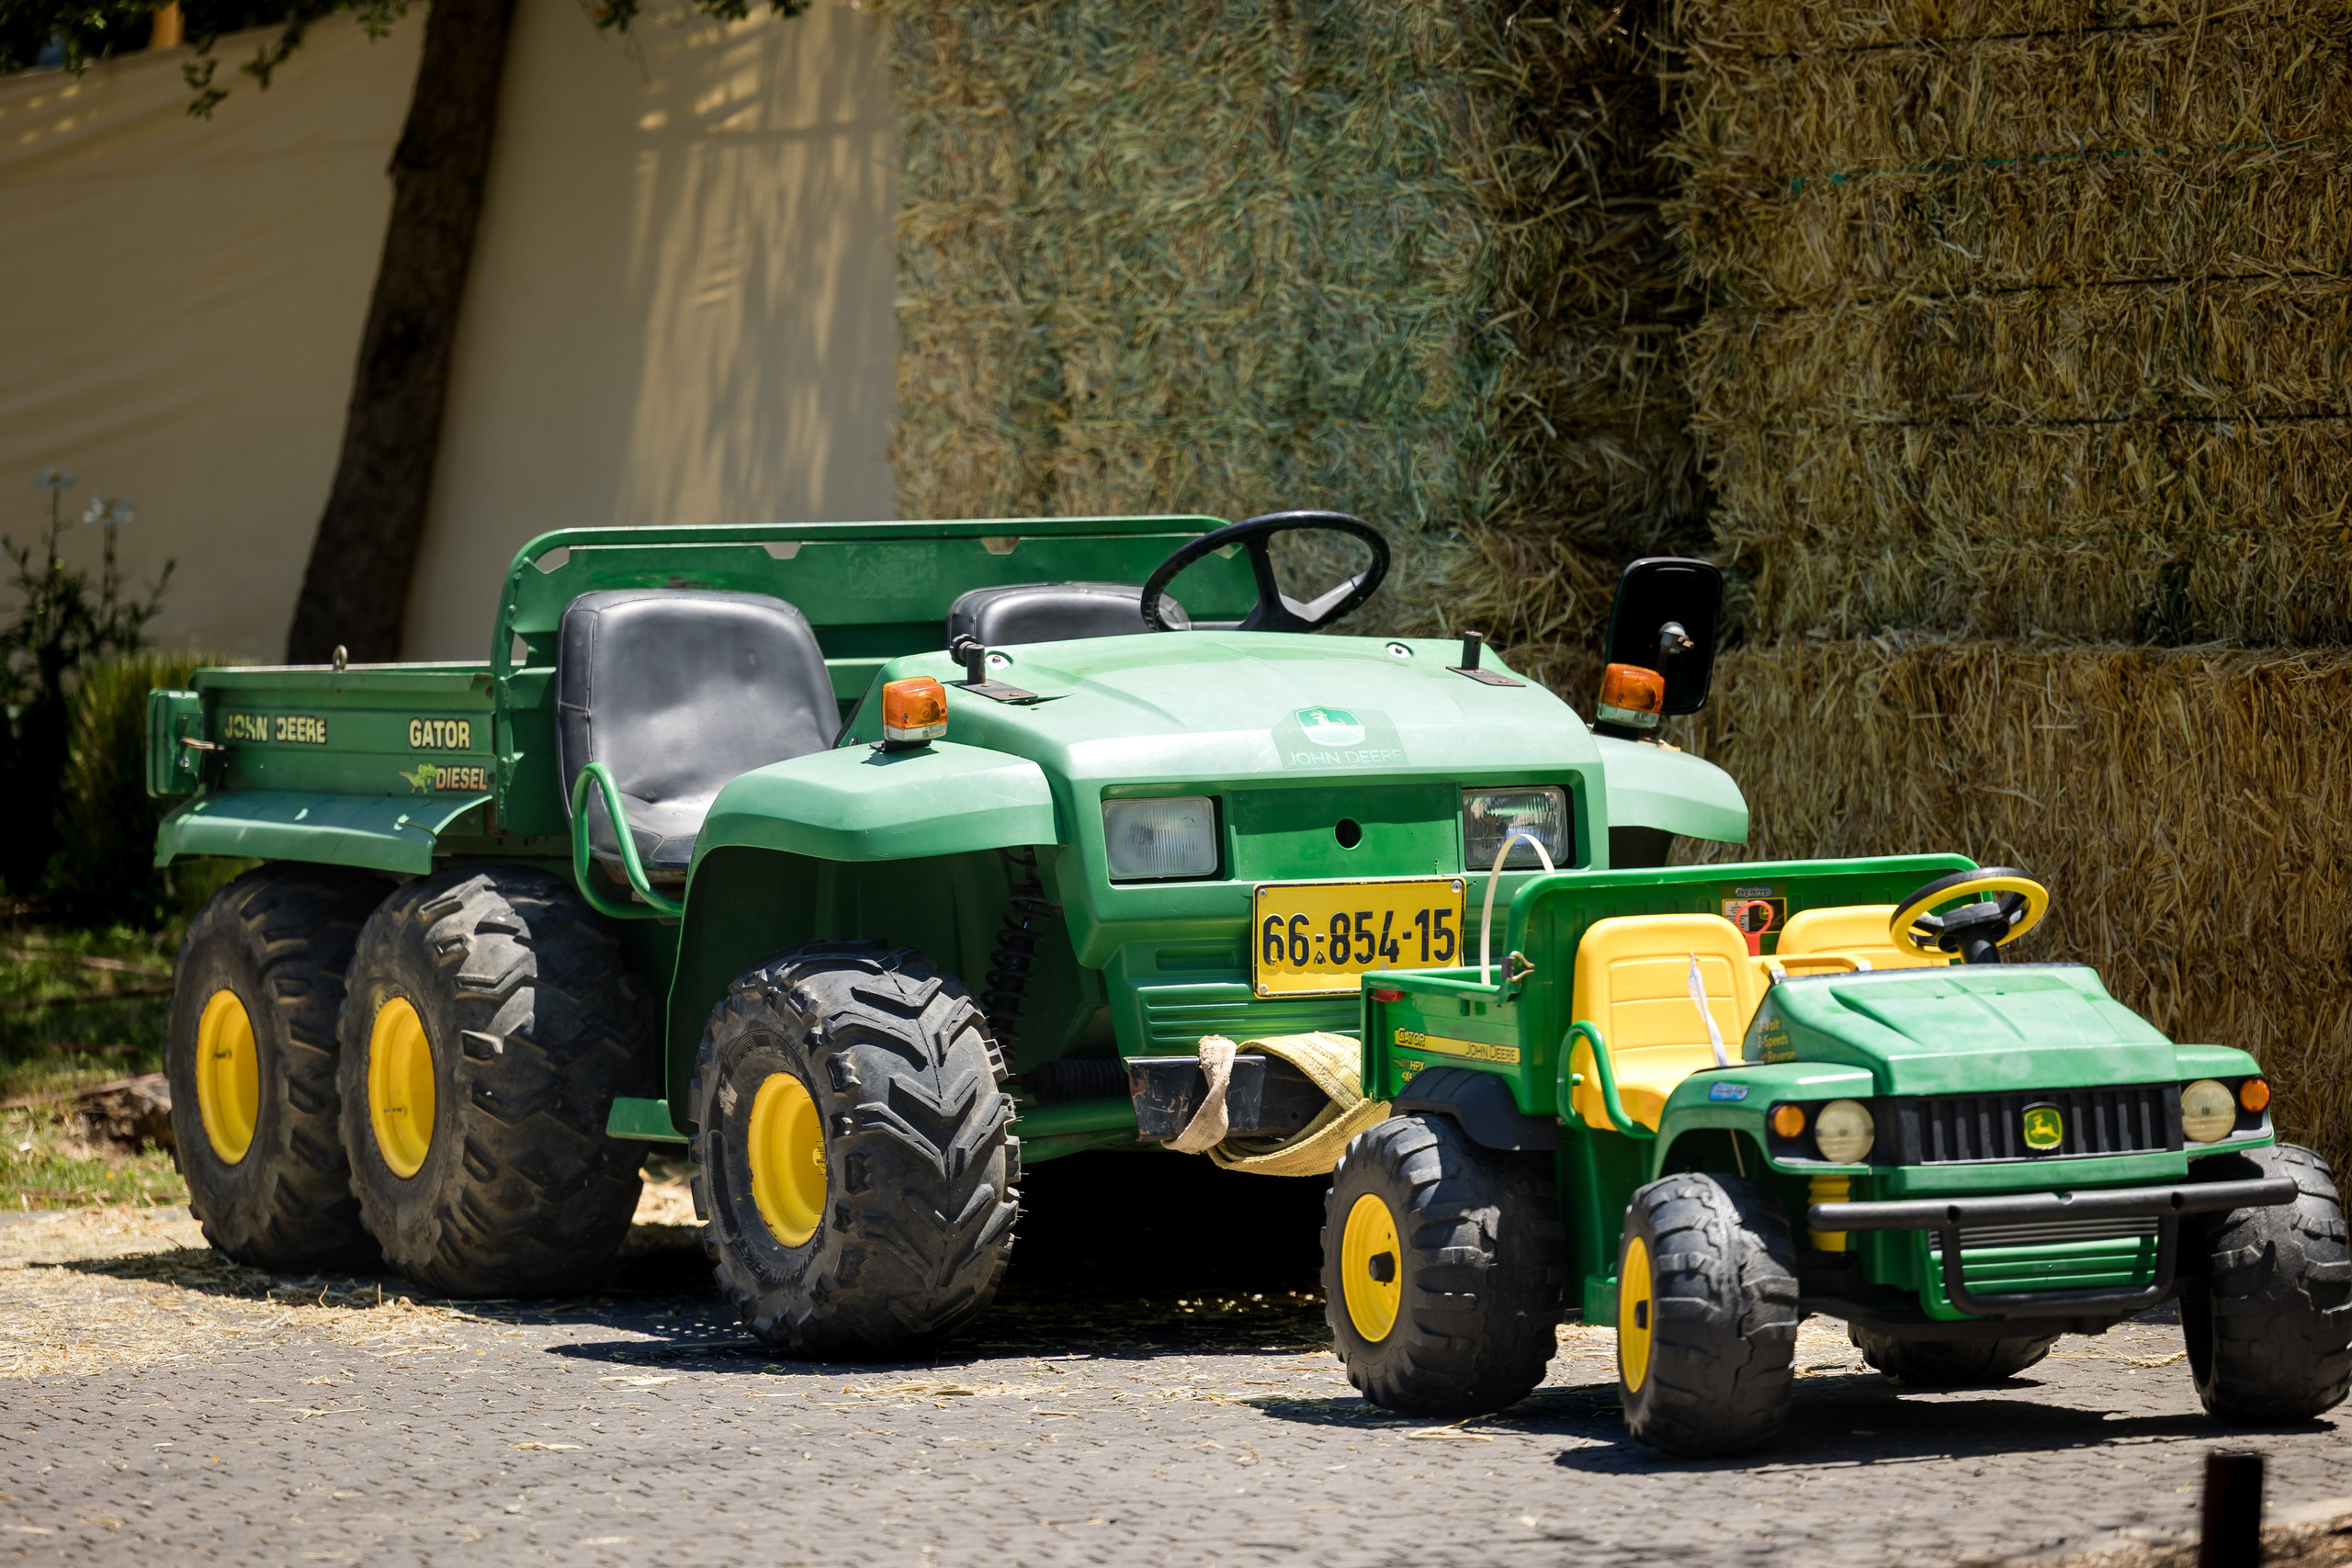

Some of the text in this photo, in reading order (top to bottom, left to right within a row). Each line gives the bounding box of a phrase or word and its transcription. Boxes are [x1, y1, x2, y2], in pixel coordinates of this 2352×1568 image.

[224, 714, 327, 744] JOHN DEERE
[409, 718, 470, 749] GATOR
[1287, 749, 1406, 766] JOHN DEERE
[435, 766, 488, 791] DIESEL
[1397, 1027, 1425, 1046] GATOR
[1465, 1042, 1516, 1061] JOHN DEERE
[1409, 1060, 1425, 1072] HPX
